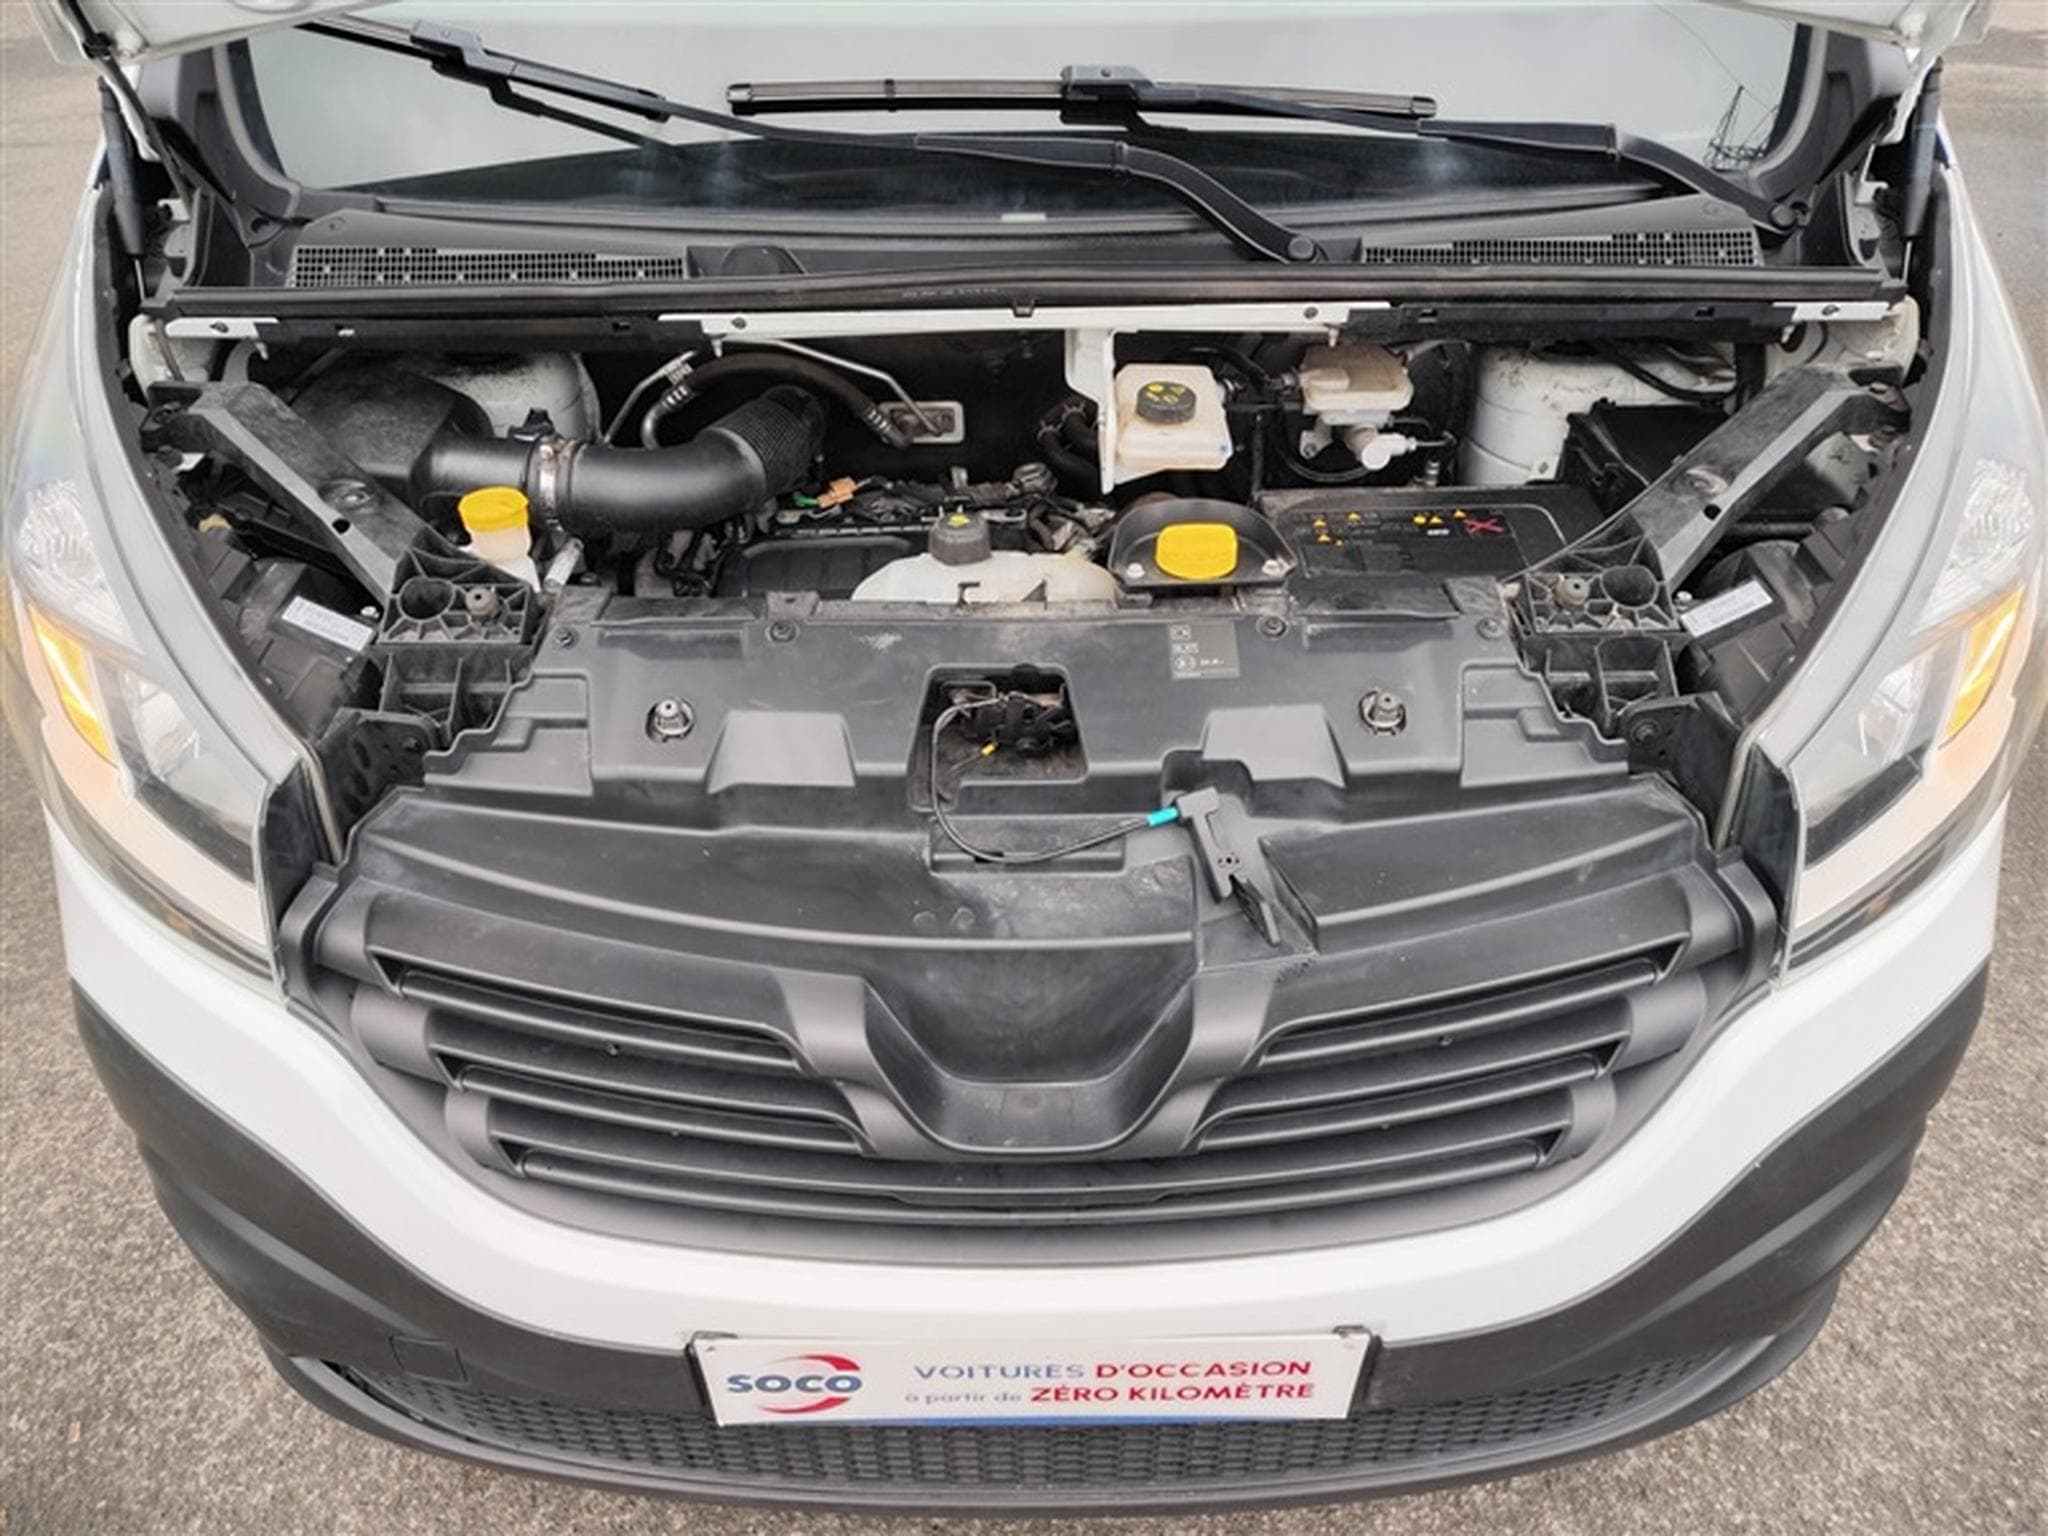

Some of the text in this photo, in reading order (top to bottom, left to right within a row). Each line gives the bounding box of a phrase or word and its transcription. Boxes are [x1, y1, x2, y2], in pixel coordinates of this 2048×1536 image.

[914, 1361, 1312, 1379] VOITURES D'OCCASION
[727, 1374, 862, 1393] SOCO
[926, 1390, 985, 1405] partir
[994, 1391, 1022, 1402] de
[1031, 1383, 1119, 1402] ZÉRO
[1128, 1382, 1315, 1401] KILOMÈTRE
